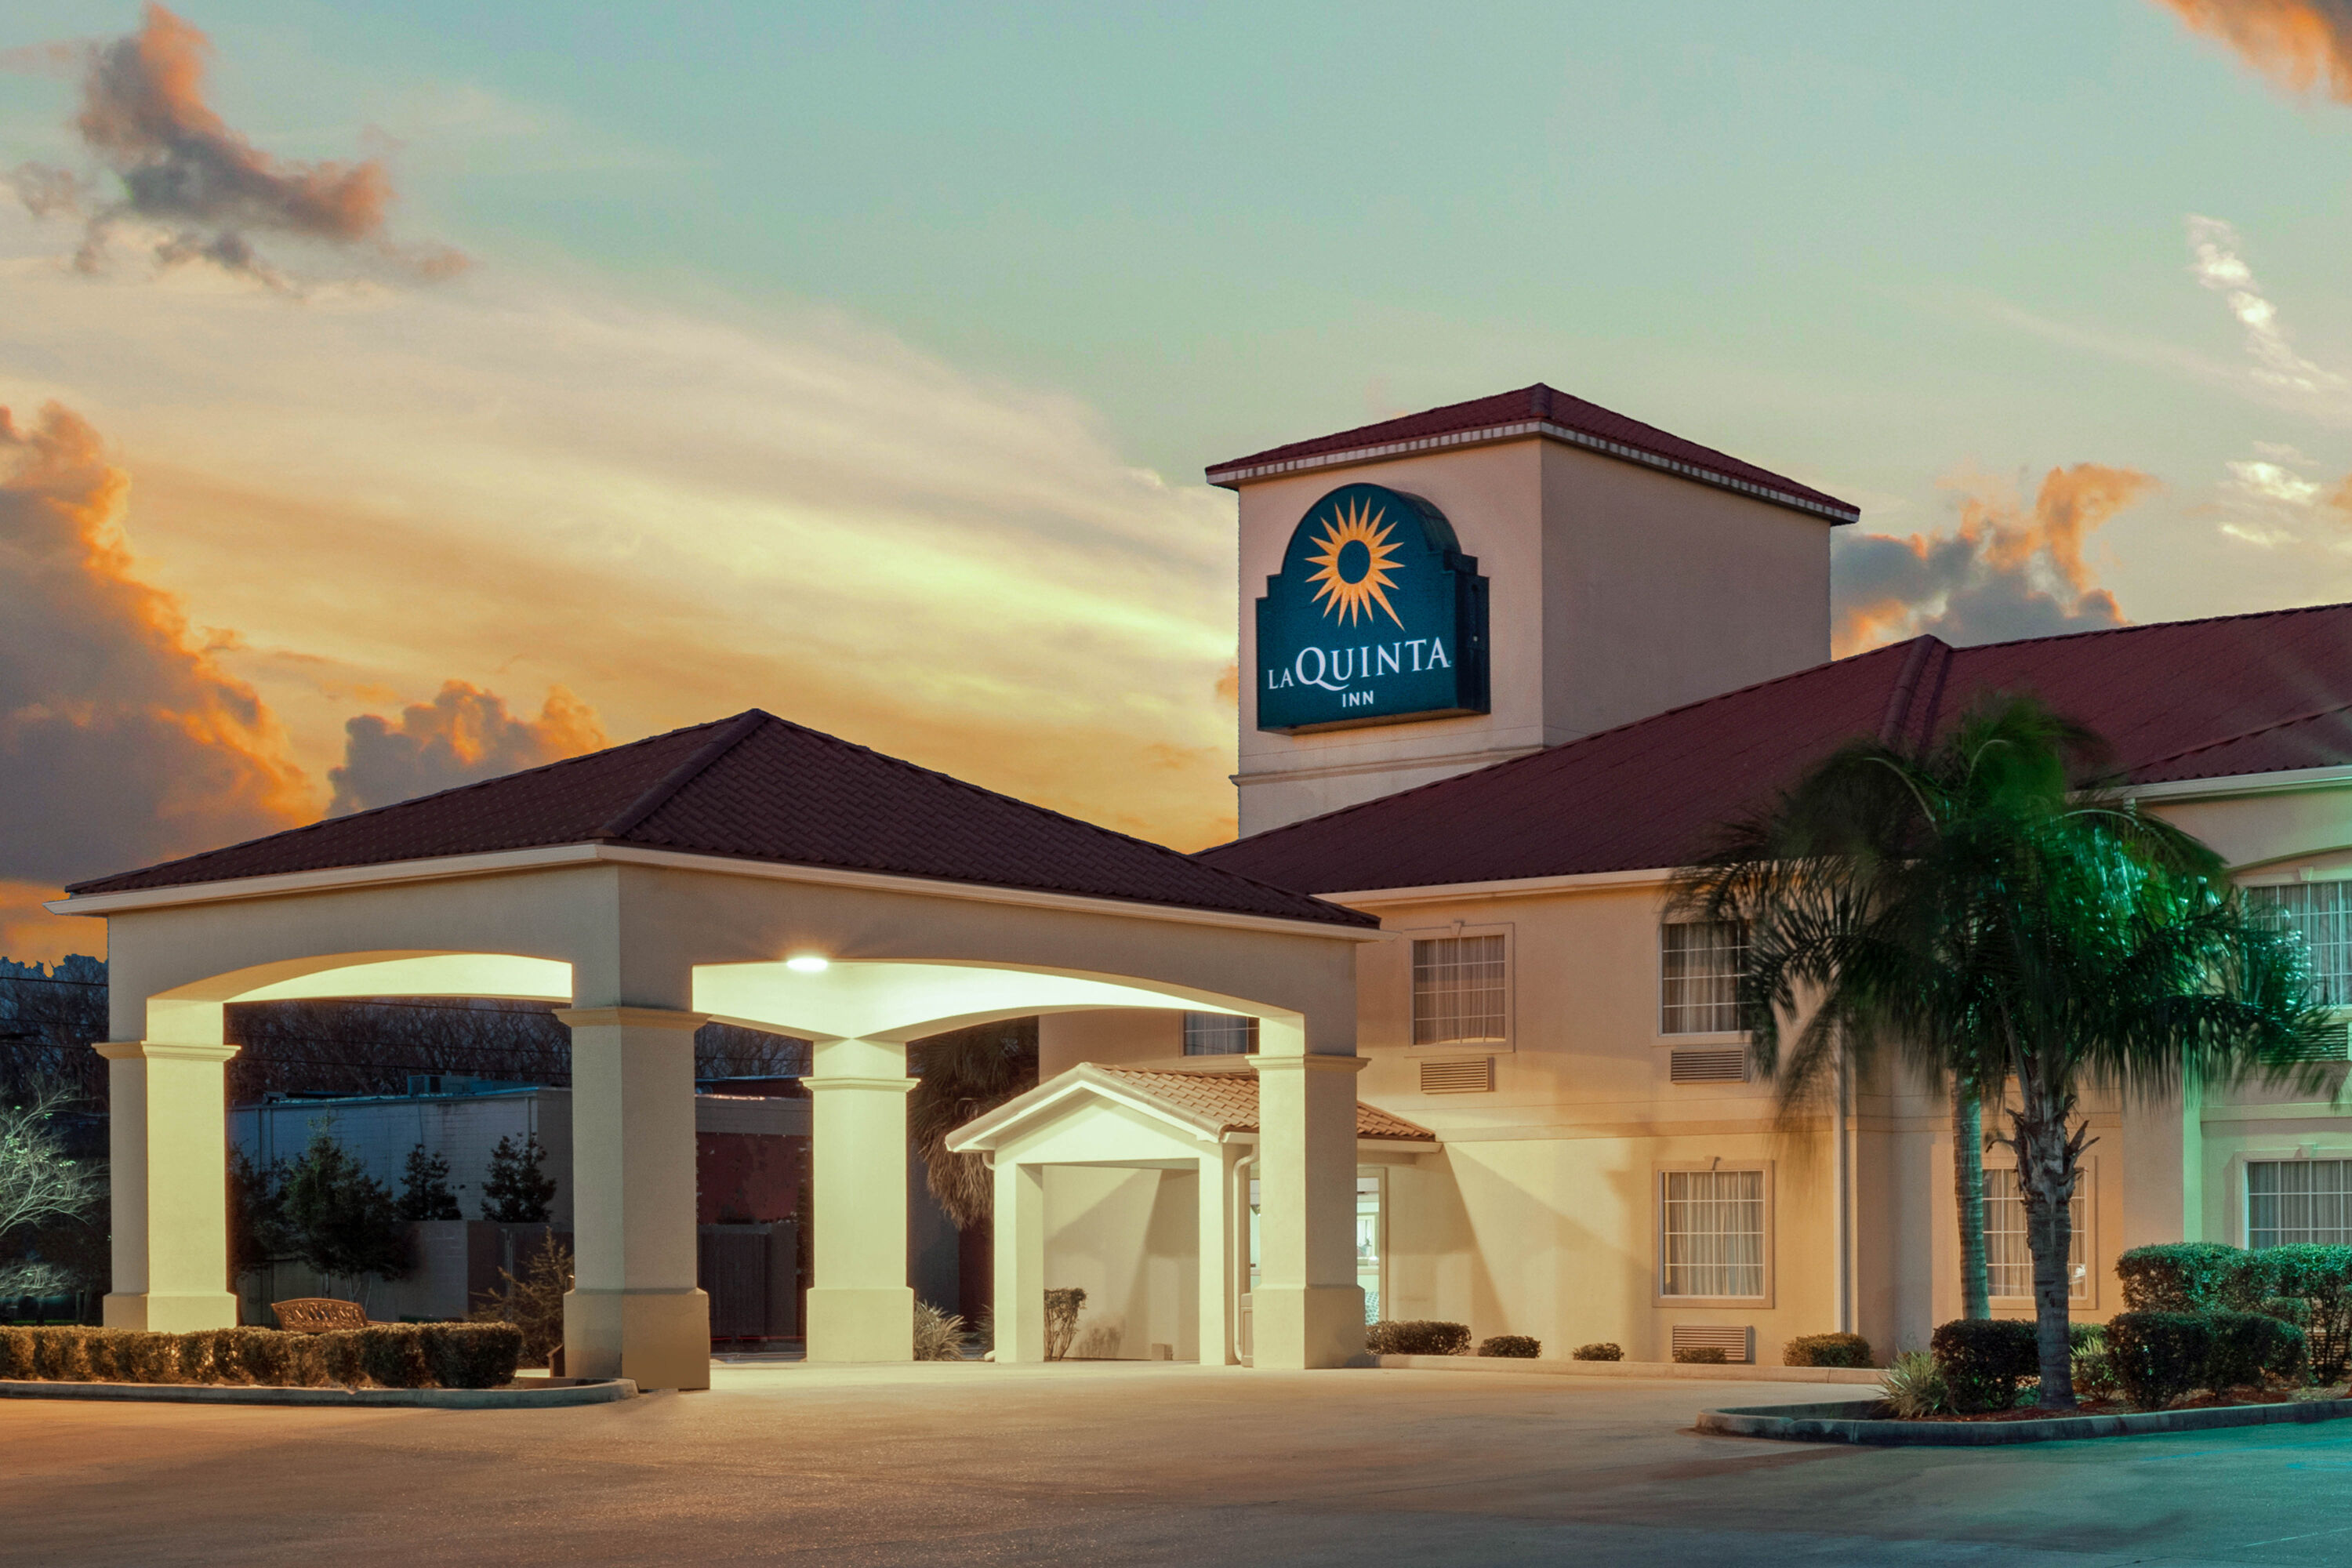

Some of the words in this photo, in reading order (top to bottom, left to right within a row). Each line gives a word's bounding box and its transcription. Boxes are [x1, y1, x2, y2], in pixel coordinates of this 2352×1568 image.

[1268, 667, 1294, 690] LA
[1295, 637, 1450, 691] QUINTA
[1342, 691, 1374, 707] INN
